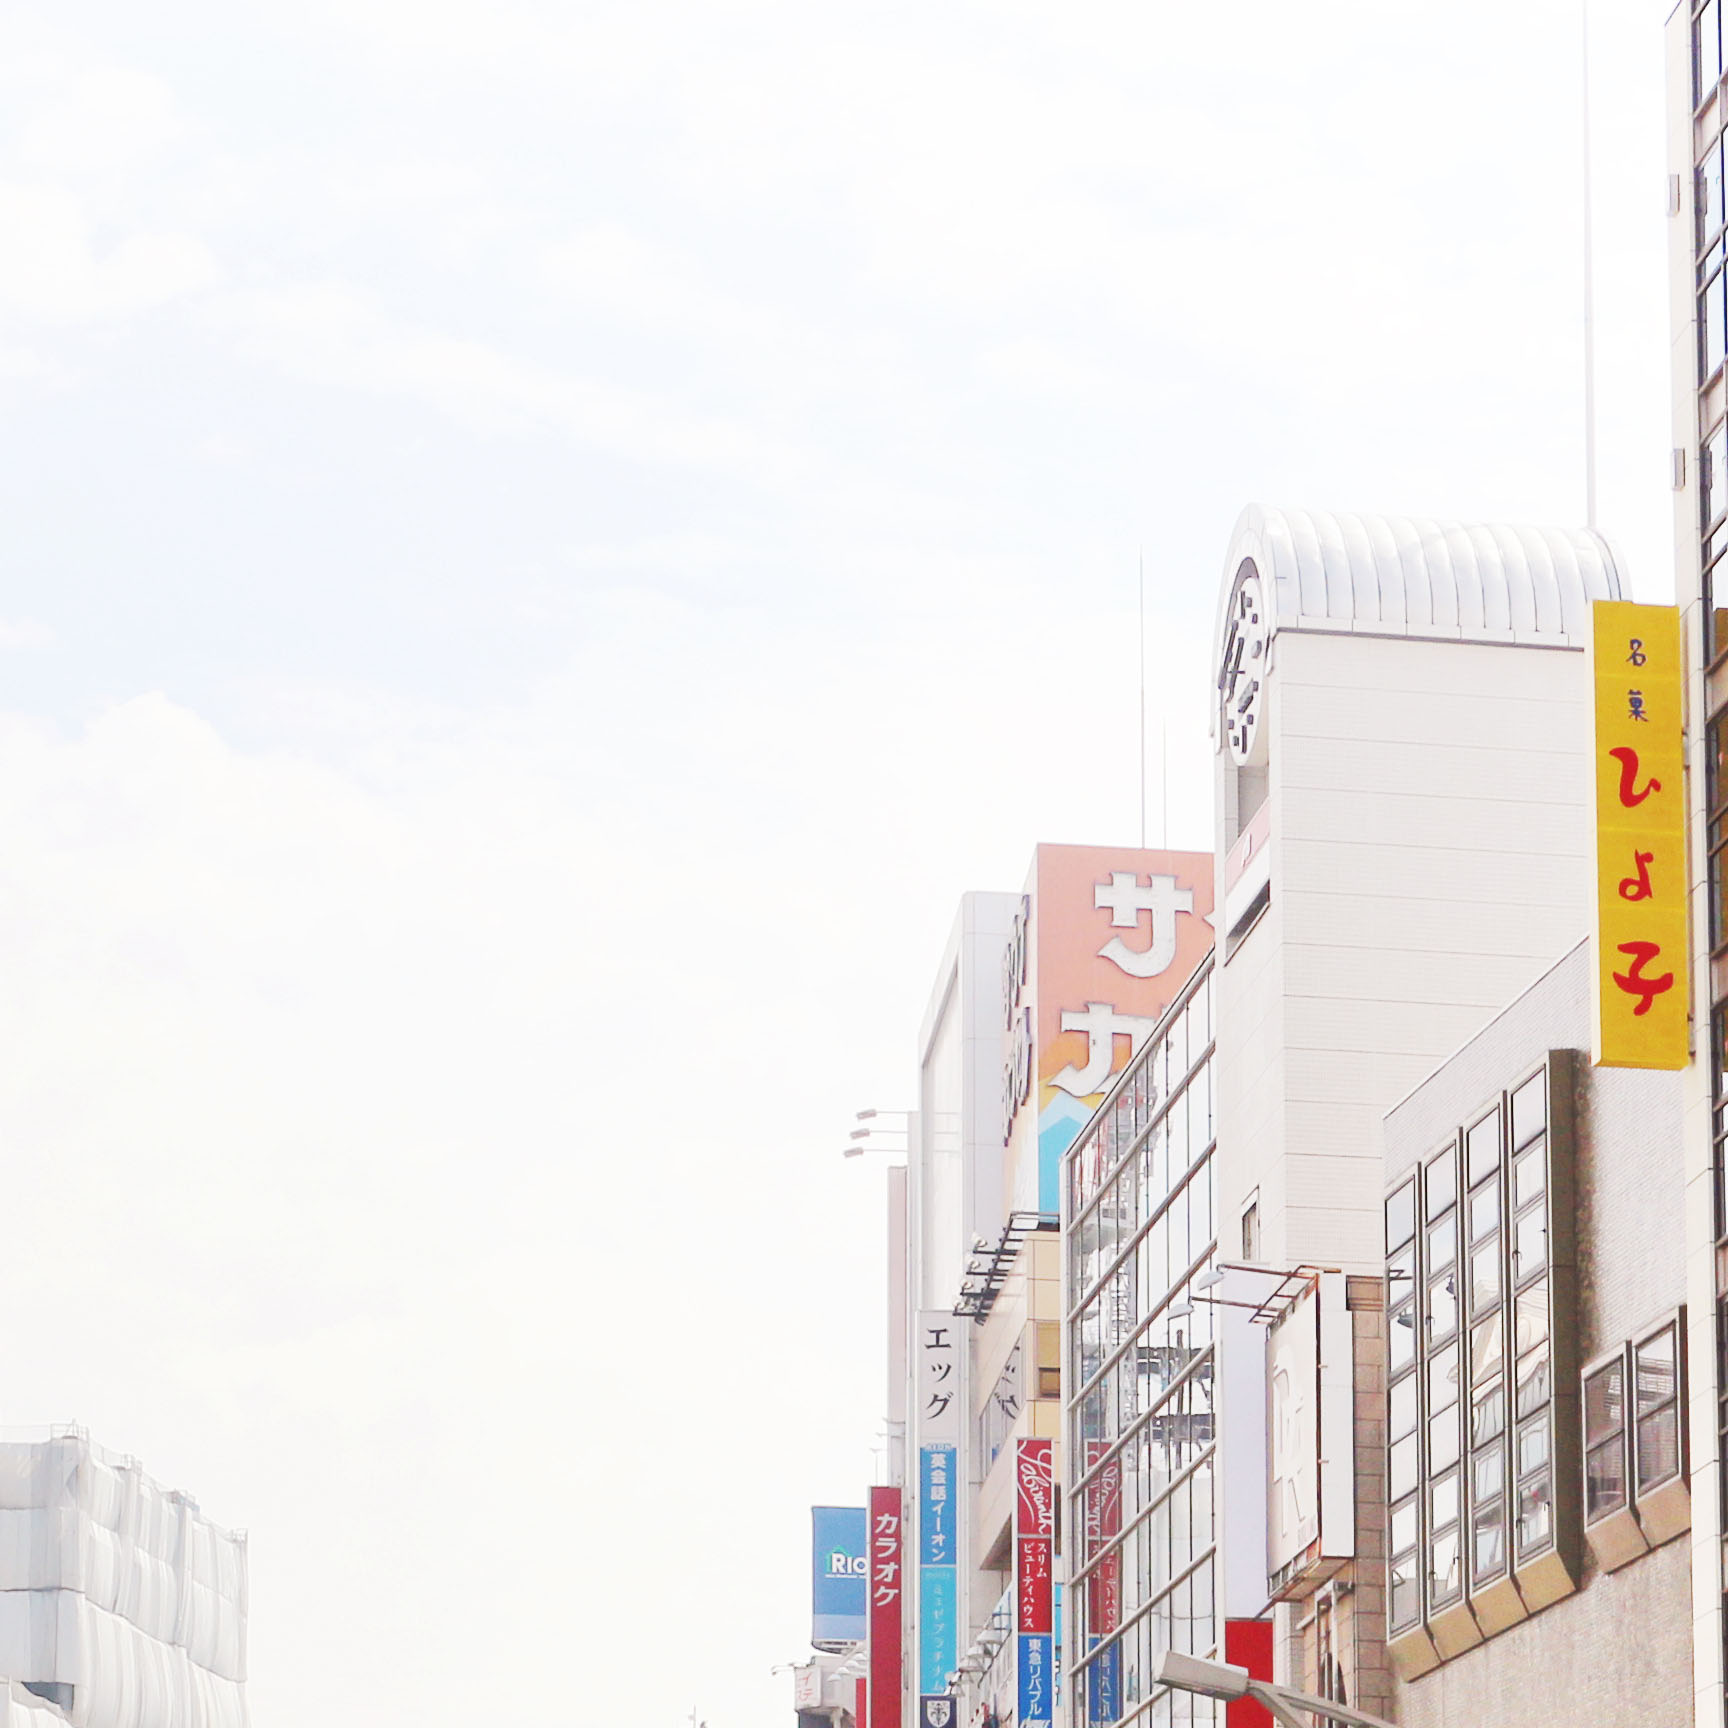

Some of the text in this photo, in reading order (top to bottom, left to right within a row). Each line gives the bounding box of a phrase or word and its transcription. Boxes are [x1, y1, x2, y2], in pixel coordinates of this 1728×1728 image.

[1626, 638, 1648, 722] 名菓
[1608, 746, 1674, 1017] ひよ子
[924, 1326, 955, 1422] エッグ
[928, 1452, 948, 1563] 英会話イーオン
[874, 1513, 900, 1607] カラオケ
[1035, 1542, 1048, 1579] スリム
[1028, 1638, 1042, 1716] 東急リバブル
